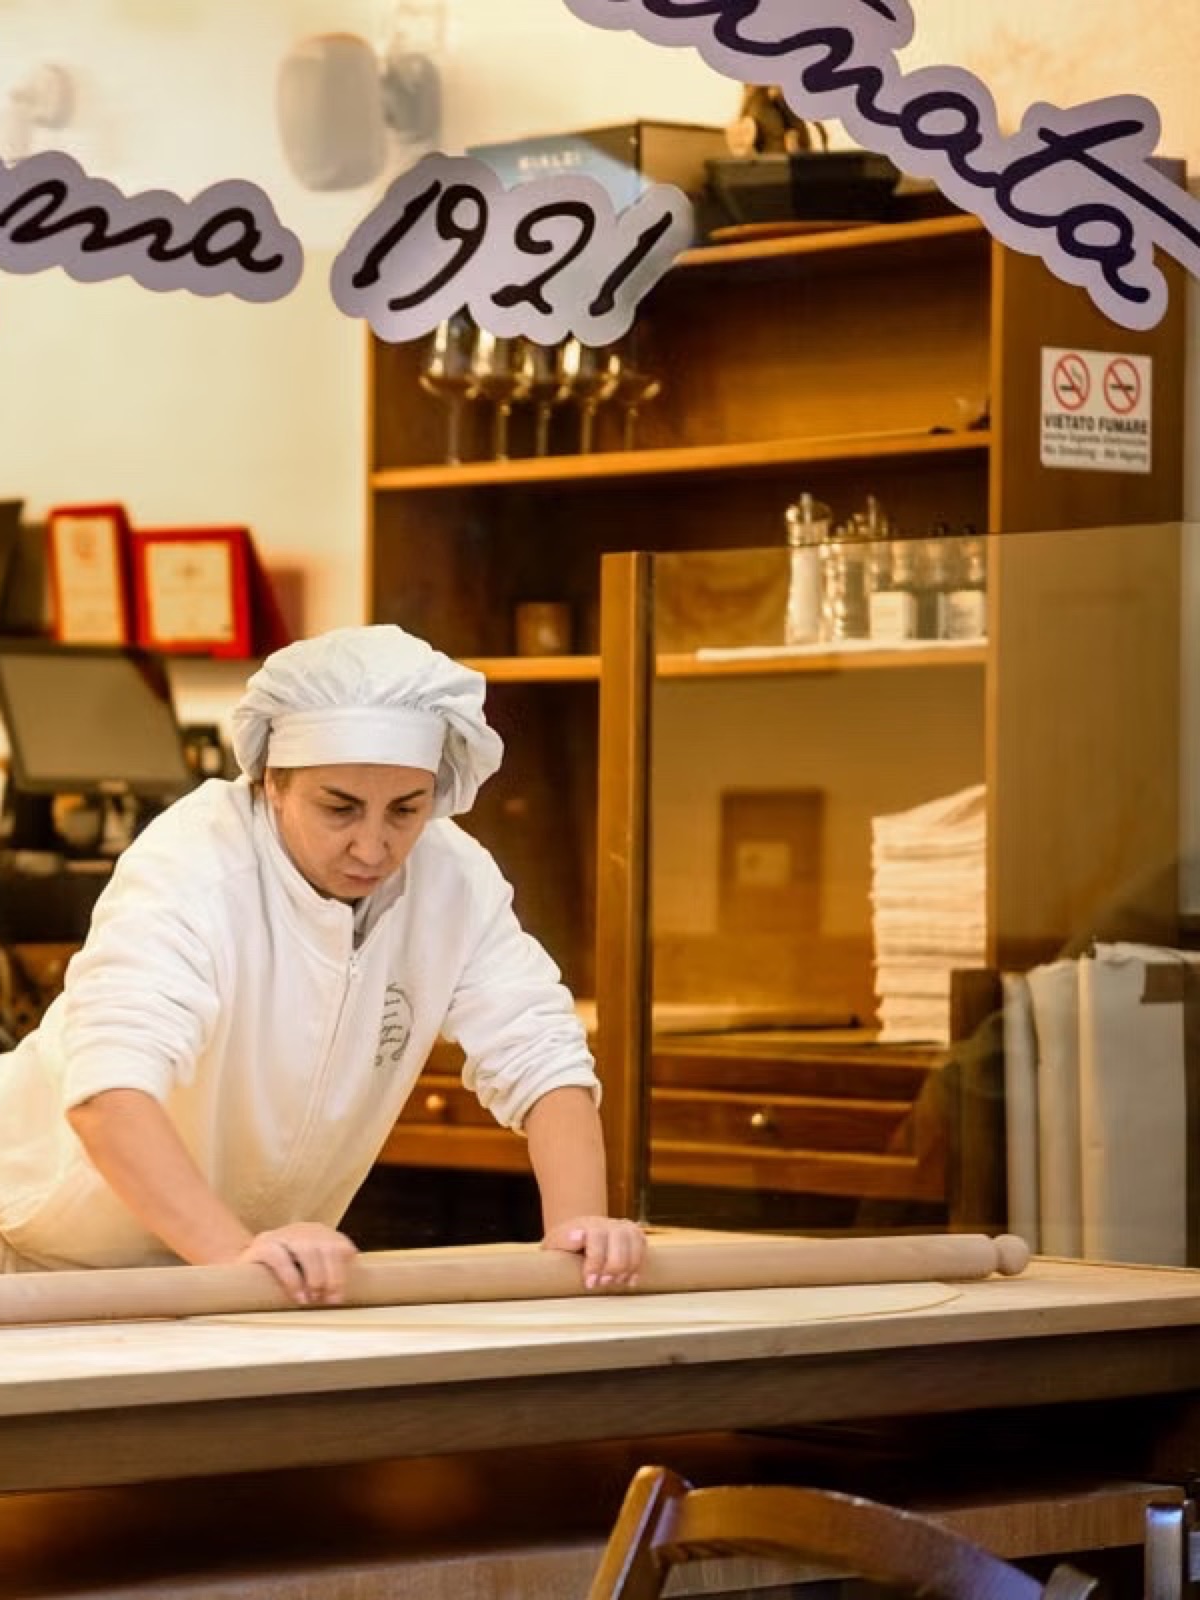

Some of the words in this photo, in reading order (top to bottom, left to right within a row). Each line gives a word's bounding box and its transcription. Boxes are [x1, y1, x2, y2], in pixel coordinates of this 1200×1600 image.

[352, 179, 674, 318] 1921
[1044, 414, 1095, 430] VIETATO
[1098, 417, 1147, 435] FUMARE
